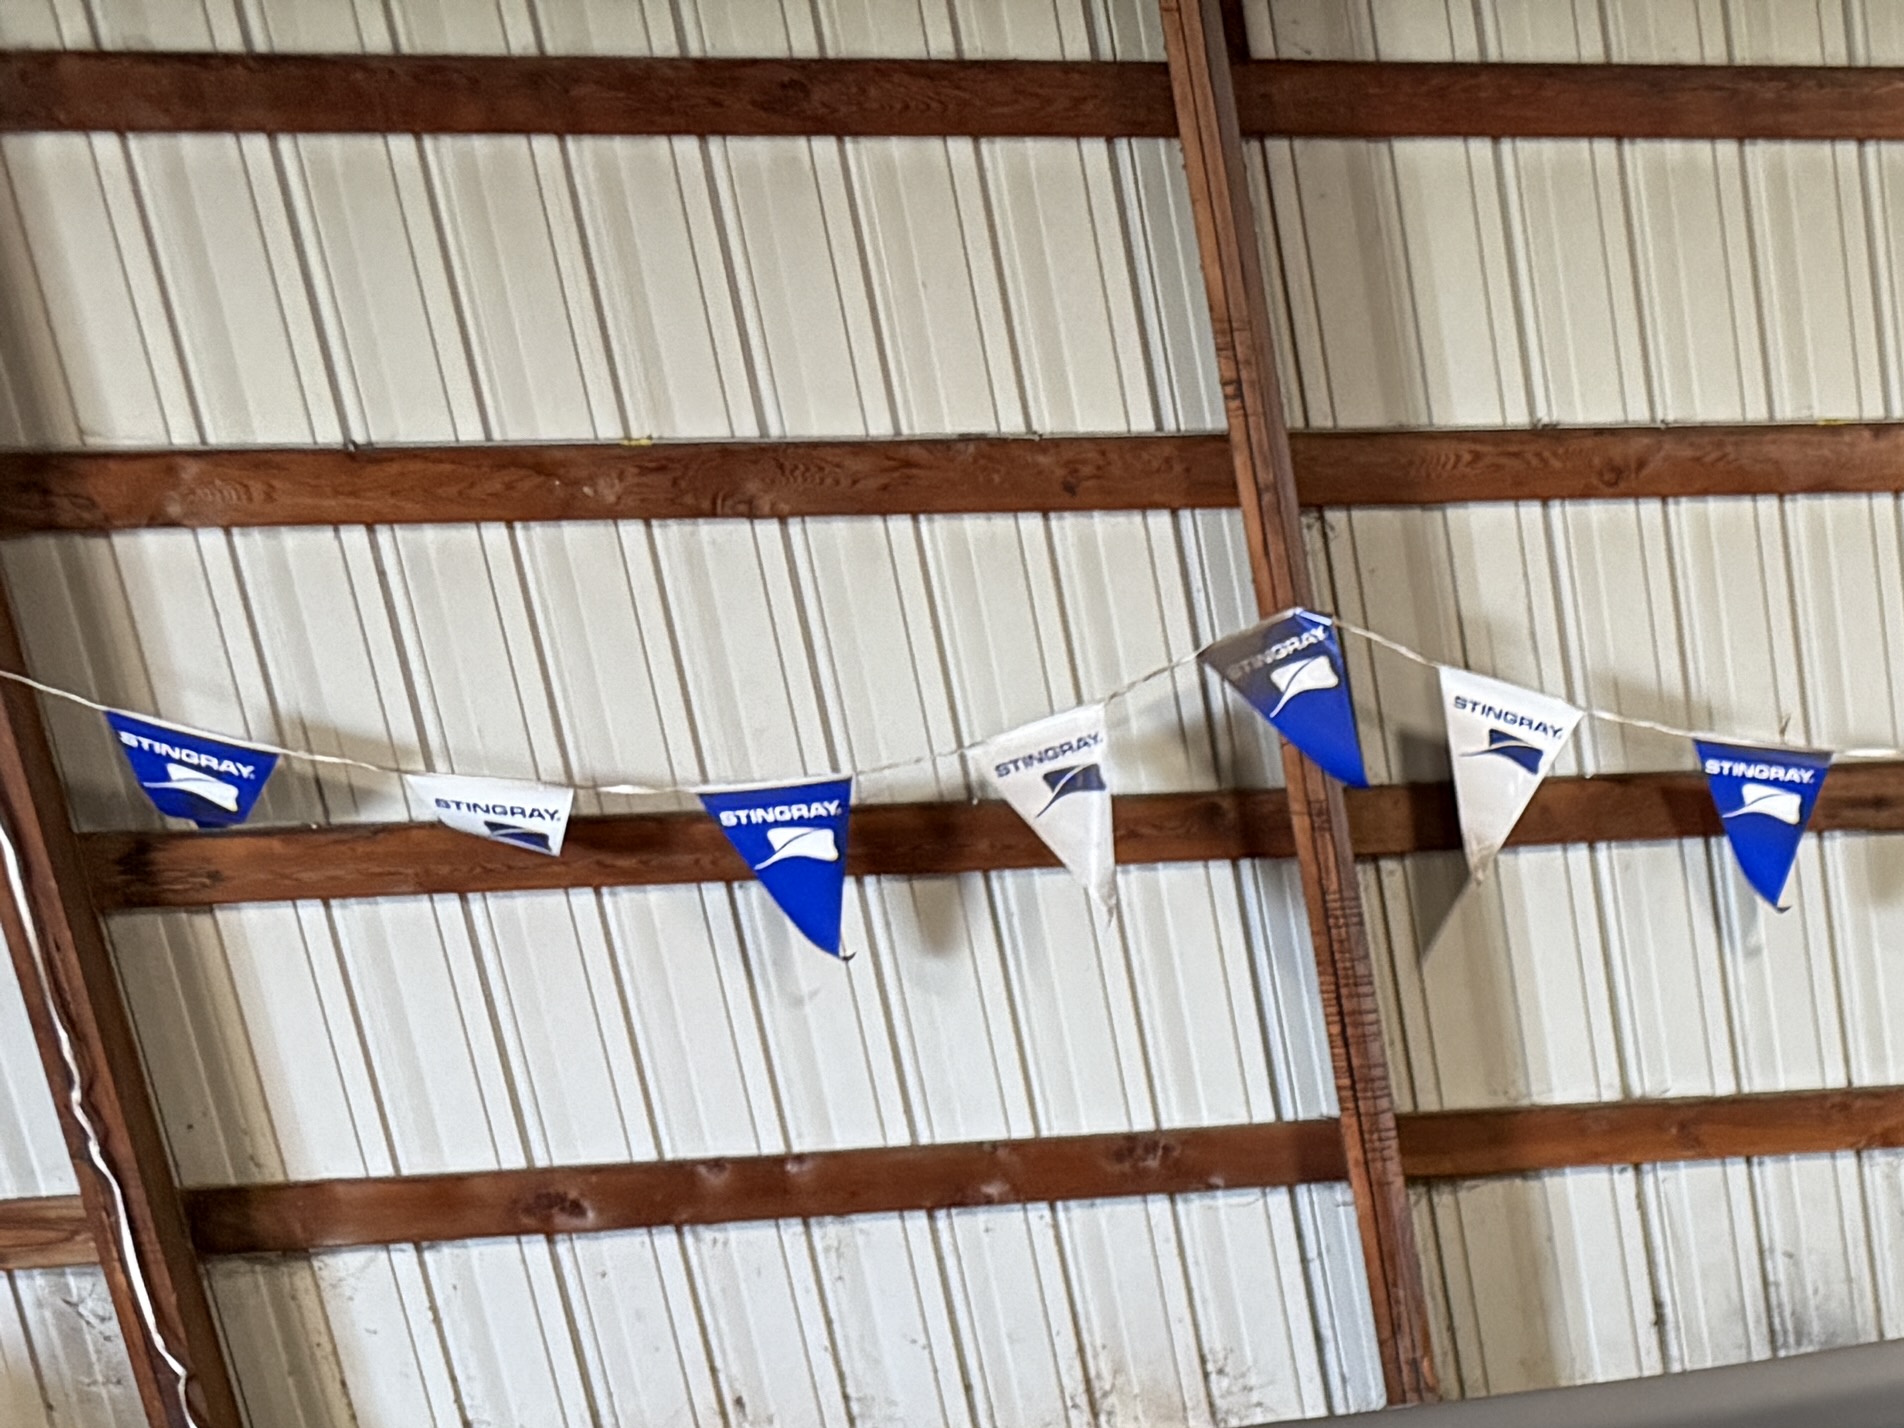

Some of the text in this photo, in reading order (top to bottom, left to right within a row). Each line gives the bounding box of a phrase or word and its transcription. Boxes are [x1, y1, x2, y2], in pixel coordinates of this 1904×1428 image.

[1453, 694, 1564, 740] STINGRAY
[118, 730, 256, 779] STINGRAY
[994, 732, 1104, 779] STINGRAY
[1703, 758, 1815, 784] STINGRAY
[435, 798, 561, 821] STINGRAY
[719, 799, 841, 827] STINGRAY
